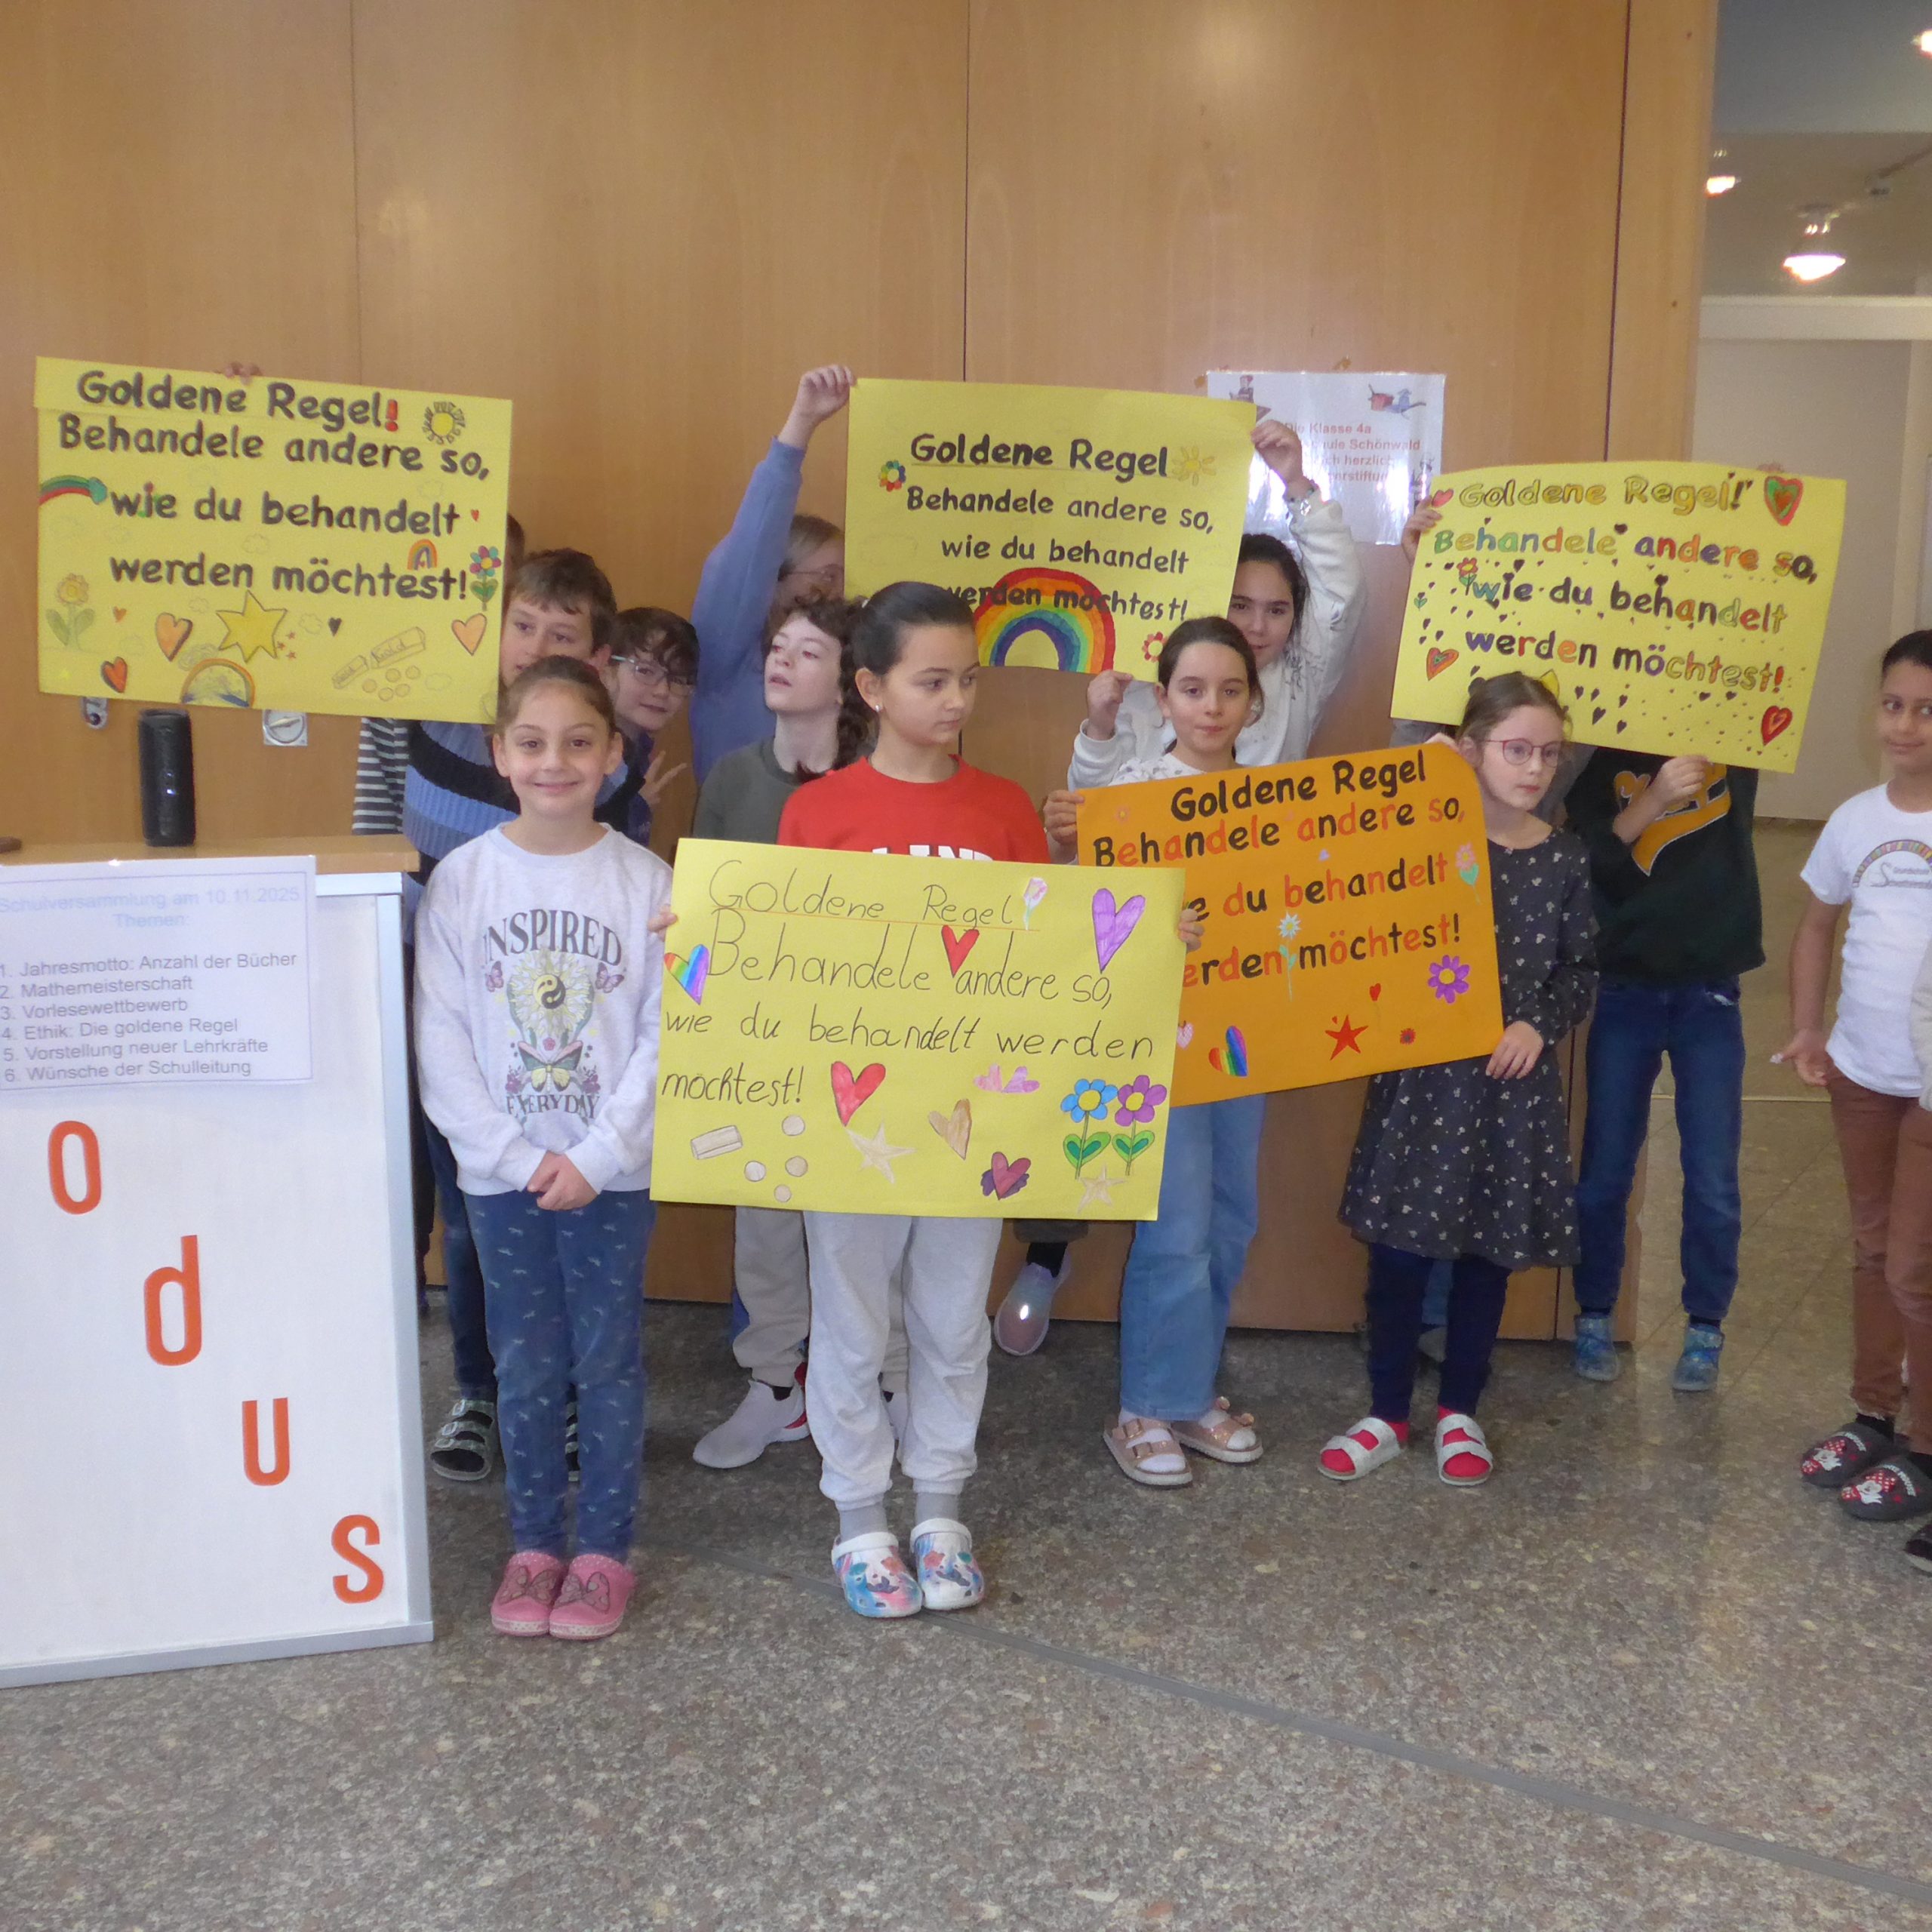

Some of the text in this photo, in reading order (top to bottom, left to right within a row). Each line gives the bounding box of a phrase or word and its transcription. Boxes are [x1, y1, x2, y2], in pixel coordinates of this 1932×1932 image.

[77, 369, 399, 432] Goldene Regel!
[58, 413, 490, 481] Behandele andere so,
[1309, 423, 1352, 435] Klasse
[1356, 423, 1372, 435] 4a
[911, 433, 1168, 483] Goldene Regel
[110, 481, 460, 537] wie du behandelt
[906, 485, 1214, 535] Behandele andere so,
[1459, 478, 1607, 509] Goldene
[110, 553, 467, 601] werden möchtest!
[942, 534, 1189, 575] wie du behandelt
[1434, 527, 1817, 584] Behandele andere so,
[1472, 572, 1787, 634] wie du behandelt
[1466, 629, 1784, 694] werden möchtest!
[1171, 749, 1426, 821] Goldene Regel
[1093, 797, 1465, 868] Behandele andere so,
[709, 859, 885, 920] Goldene
[1223, 881, 1268, 917] du
[1284, 852, 1448, 908] behandelt
[20, 958, 134, 977] Jahresmotto:
[139, 954, 198, 971] Anzahl
[204, 954, 232, 969] der
[237, 952, 297, 968] Bücher
[708, 907, 1113, 1011] Behandele andere so,
[1183, 913, 1460, 987] erden möchtest!
[20, 977, 194, 998] Mathemeisterschaft
[23, 997, 189, 1019] Vorlesewettbewerb
[24, 1024, 72, 1040] Ethik:
[79, 1022, 109, 1037] Die
[115, 1019, 183, 1038] goldene
[189, 1017, 238, 1036] Regel
[24, 1041, 124, 1060] Vorstellung
[128, 1041, 177, 1057] neuer
[183, 1038, 269, 1055] Lehrkräfte
[665, 1001, 1154, 1060] wie du behandelt werden
[26, 1063, 110, 1081] Wünsche
[115, 1062, 143, 1076] der
[149, 1058, 251, 1077] Schulleitung
